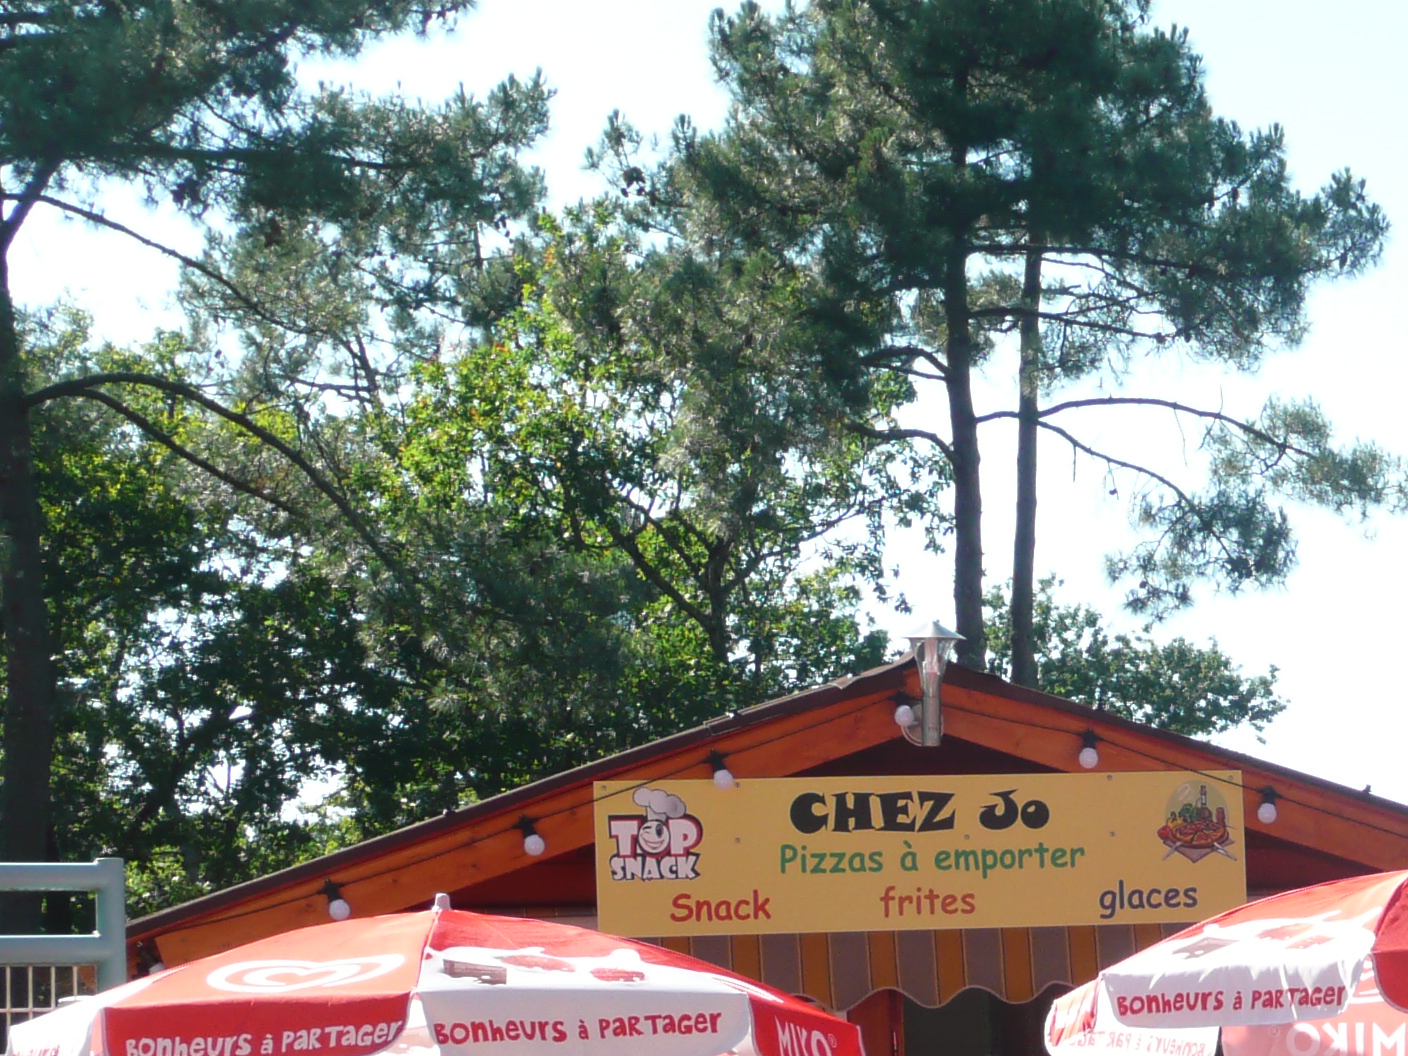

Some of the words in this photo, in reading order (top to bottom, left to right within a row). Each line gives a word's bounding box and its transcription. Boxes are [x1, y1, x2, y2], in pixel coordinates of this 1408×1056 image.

[790, 791, 956, 833] CHEZ
[979, 788, 1050, 829] Jo
[610, 852, 701, 880] SNACK
[780, 844, 883, 874] Pizzas
[900, 840, 918, 871] à
[934, 841, 1086, 879] emporter
[670, 889, 771, 922] Snack
[881, 885, 975, 917] frites
[1100, 879, 1199, 919] glaces
[1233, 990, 1243, 1011] à
[260, 1033, 273, 1055] à
[578, 1018, 589, 1041] à
